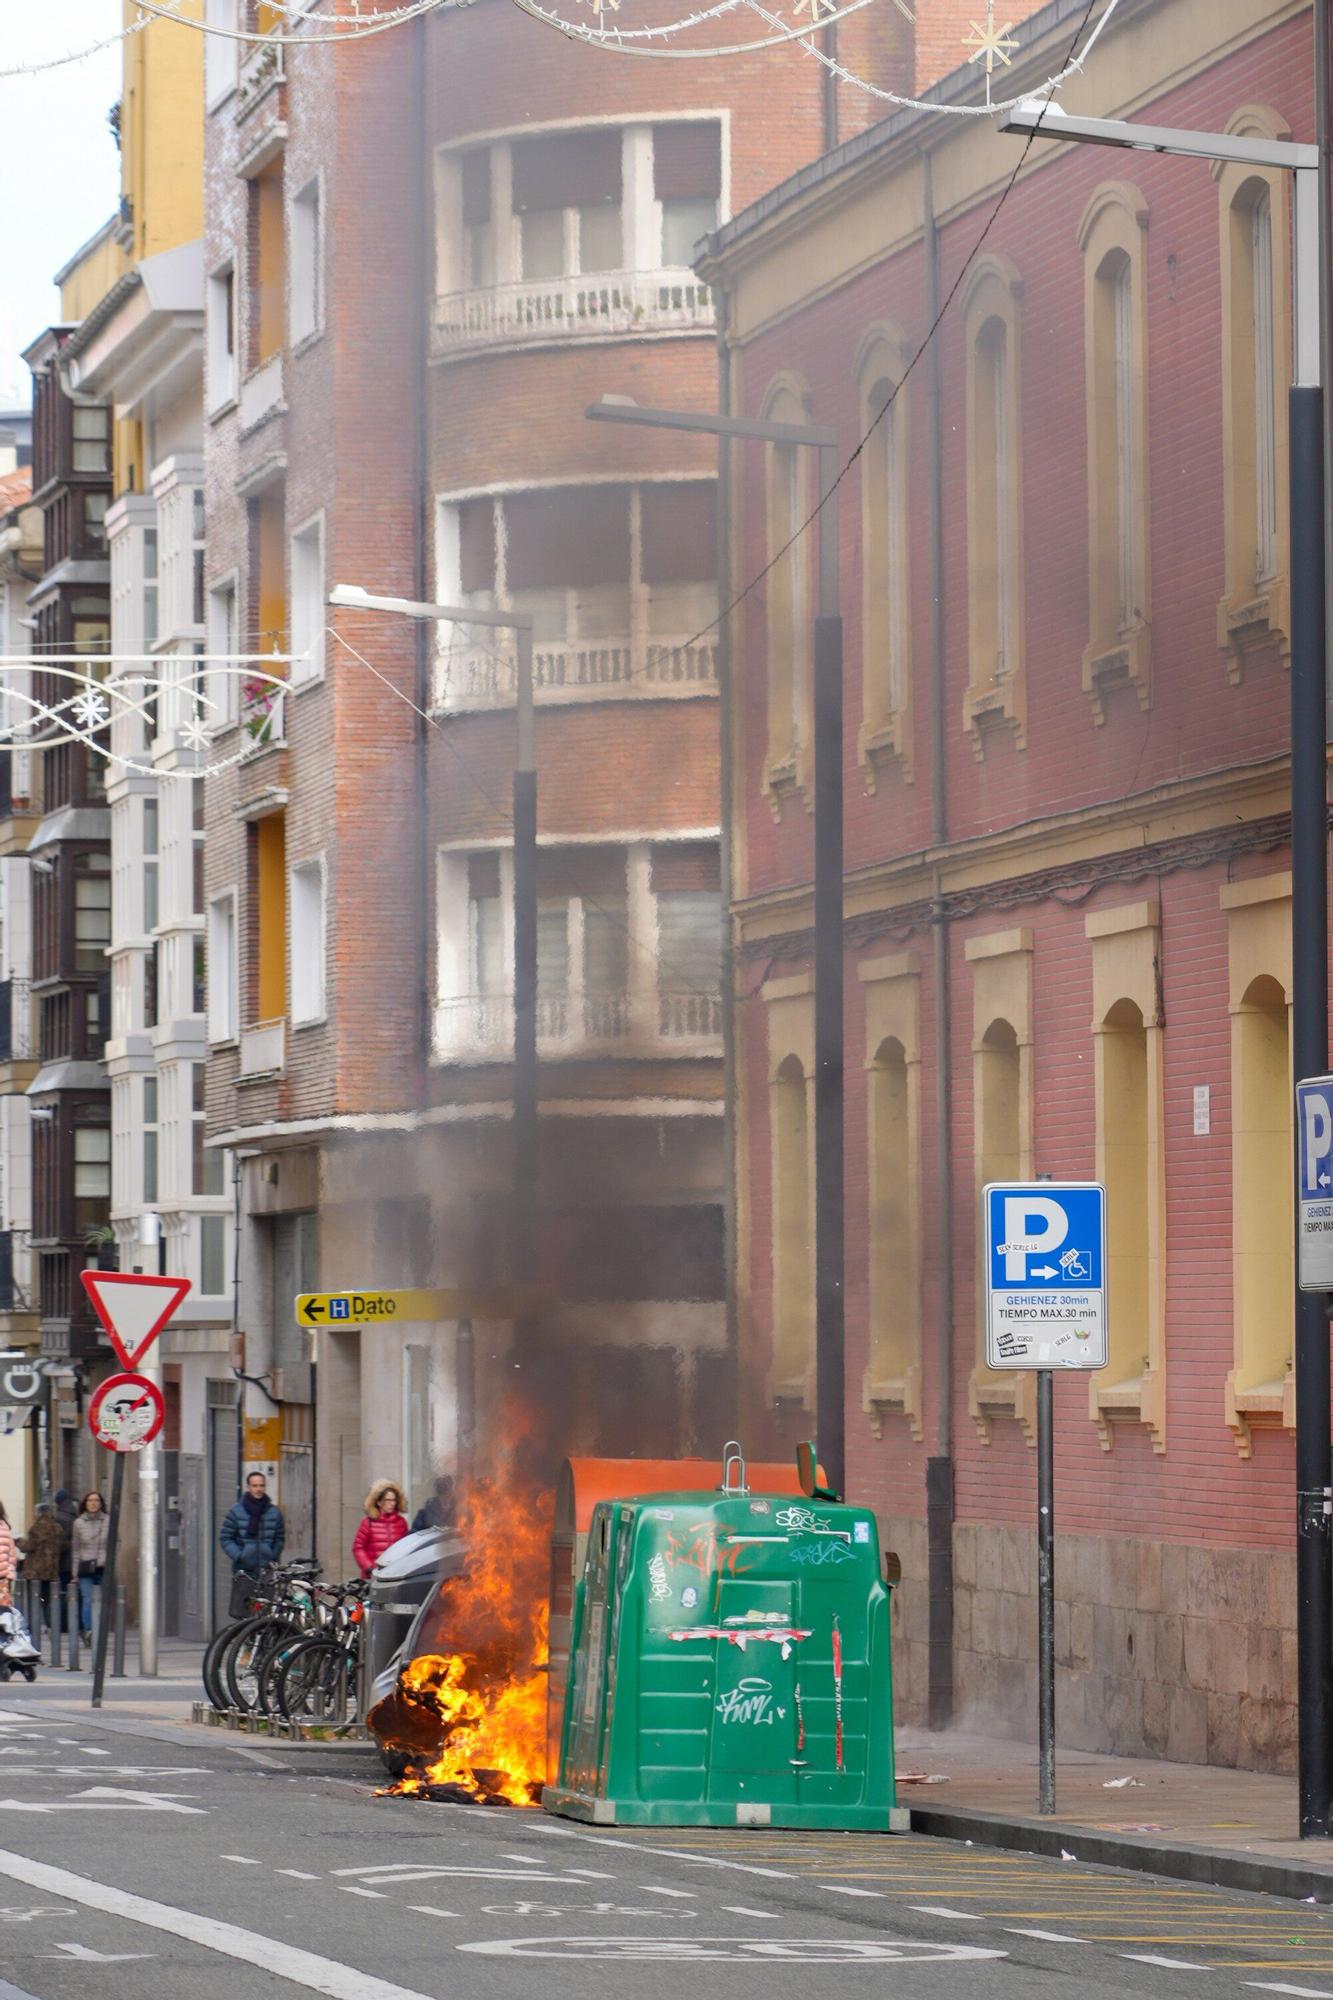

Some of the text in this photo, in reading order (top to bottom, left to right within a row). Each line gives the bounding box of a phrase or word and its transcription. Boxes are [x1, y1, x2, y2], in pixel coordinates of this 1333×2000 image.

[1303, 1093, 1332, 1191] P
[1307, 1206, 1331, 1217] GEHIENEZ
[1304, 1221, 1322, 1233] TIEMPO
[1004, 1196, 1069, 1281] P
[1006, 1295, 1089, 1305] GEHIENEZ 30min
[331, 1296, 396, 1318] H Dato
[999, 1309, 1037, 1318] TIEMPO
[1079, 1308, 1097, 1318] min
